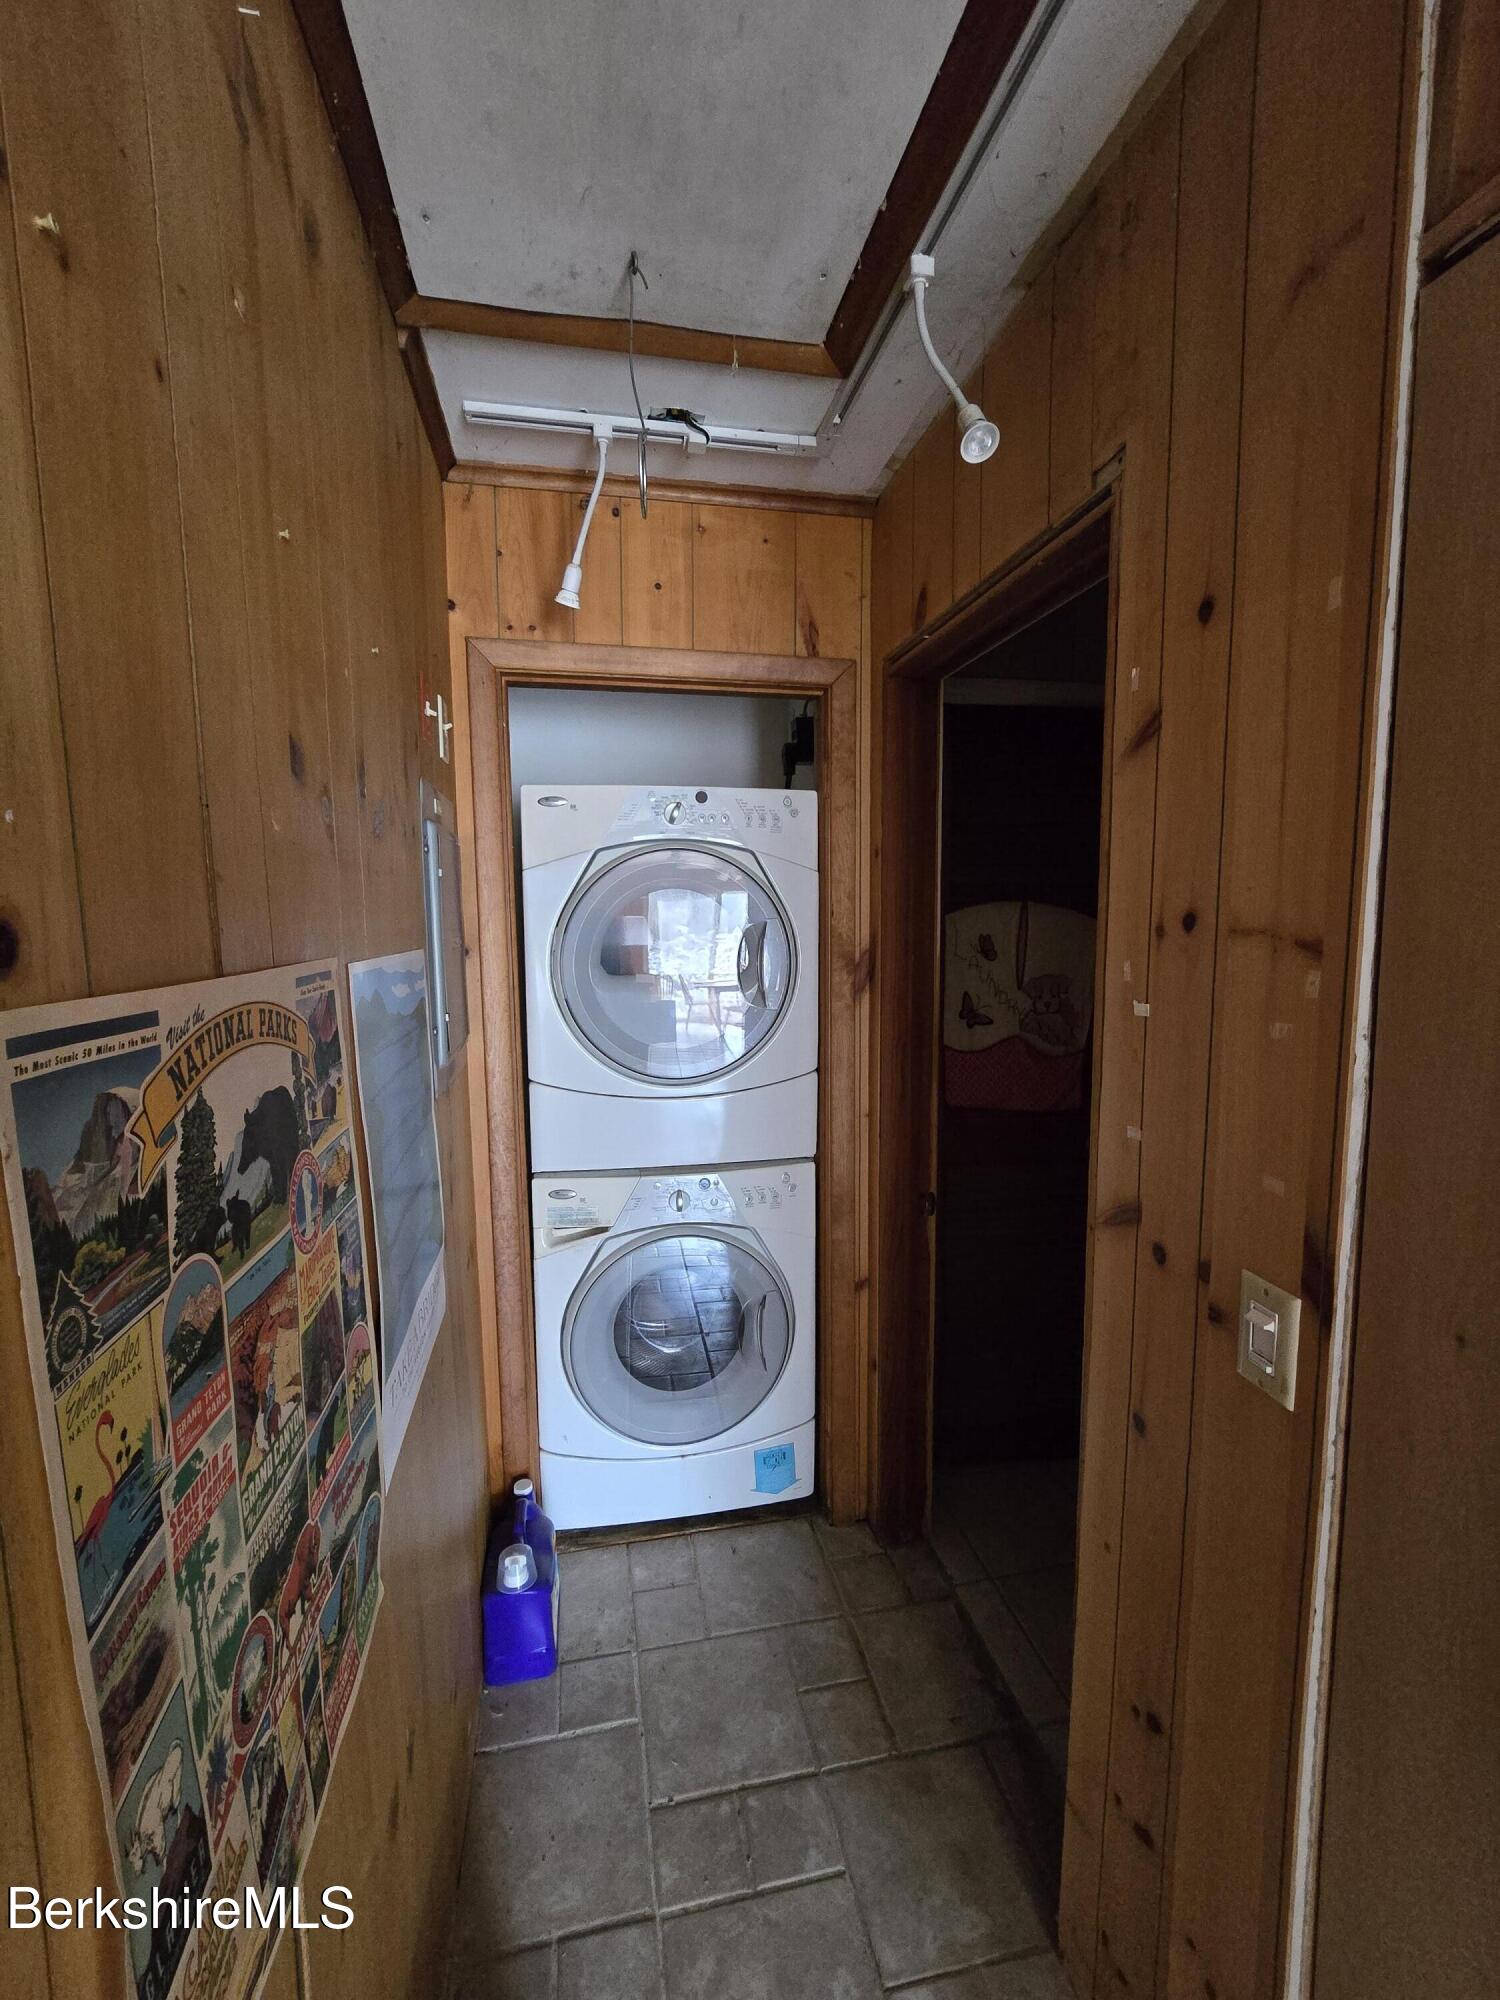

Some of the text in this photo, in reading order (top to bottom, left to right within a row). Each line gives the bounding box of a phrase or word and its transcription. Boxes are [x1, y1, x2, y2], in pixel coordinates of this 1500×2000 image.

[14, 1063, 28, 1077] The
[32, 1059, 51, 1072] Most
[55, 1051, 78, 1066] Scenic
[82, 1048, 92, 1059] 50
[95, 1043, 116, 1056] Miles
[128, 1037, 138, 1049] the
[140, 1032, 158, 1045] World
[165, 1001, 206, 1050] Visit the
[166, 1007, 297, 1102] NATIONAL PARKS
[55, 1354, 92, 1396] MEMBER
[65, 1334, 140, 1431] Everglades
[68, 1391, 117, 1442] NATIONAL
[121, 1362, 143, 1389] PARK
[176, 1374, 227, 1437] GRAND TETON
[206, 1391, 228, 1421] PARK
[201, 1452, 233, 1514] CANYON
[242, 1397, 303, 1521] GRAND CANYON
[169, 1453, 219, 1535] SEQUOIA
[295, 1610, 312, 1666] CAVE
